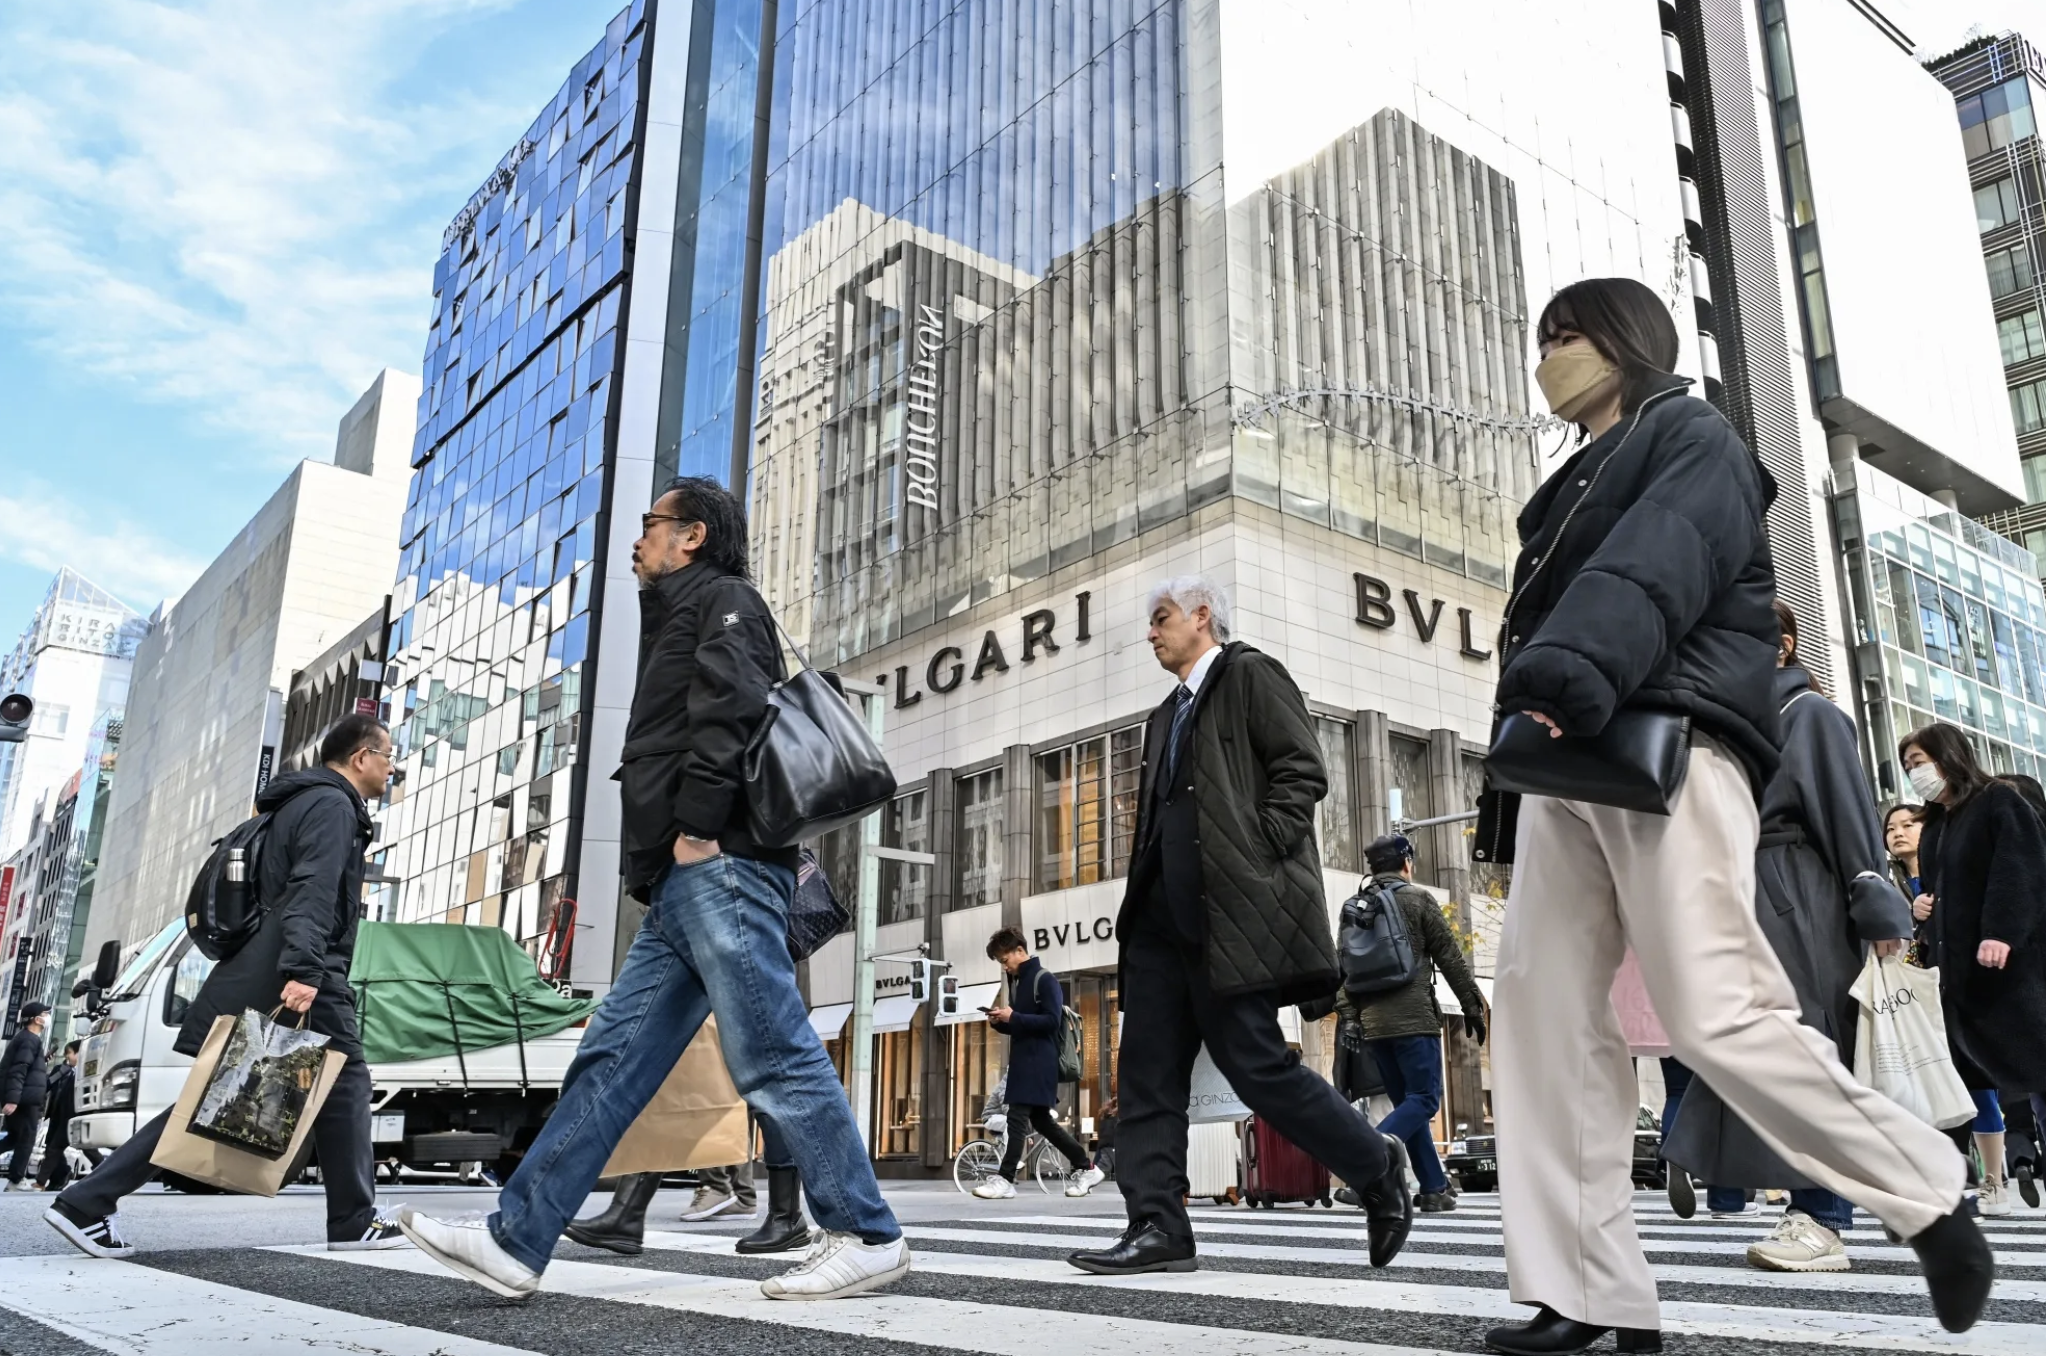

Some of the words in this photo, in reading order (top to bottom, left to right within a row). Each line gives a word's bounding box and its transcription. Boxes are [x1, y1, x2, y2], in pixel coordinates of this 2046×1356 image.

[60, 614, 116, 631] KIRA
[1353, 572, 1492, 660] BVL
[57, 634, 112, 650] GINZA
[58, 623, 115, 640] RITO
[876, 590, 1091, 709] LGARI
[1033, 916, 1114, 951] BVLG
